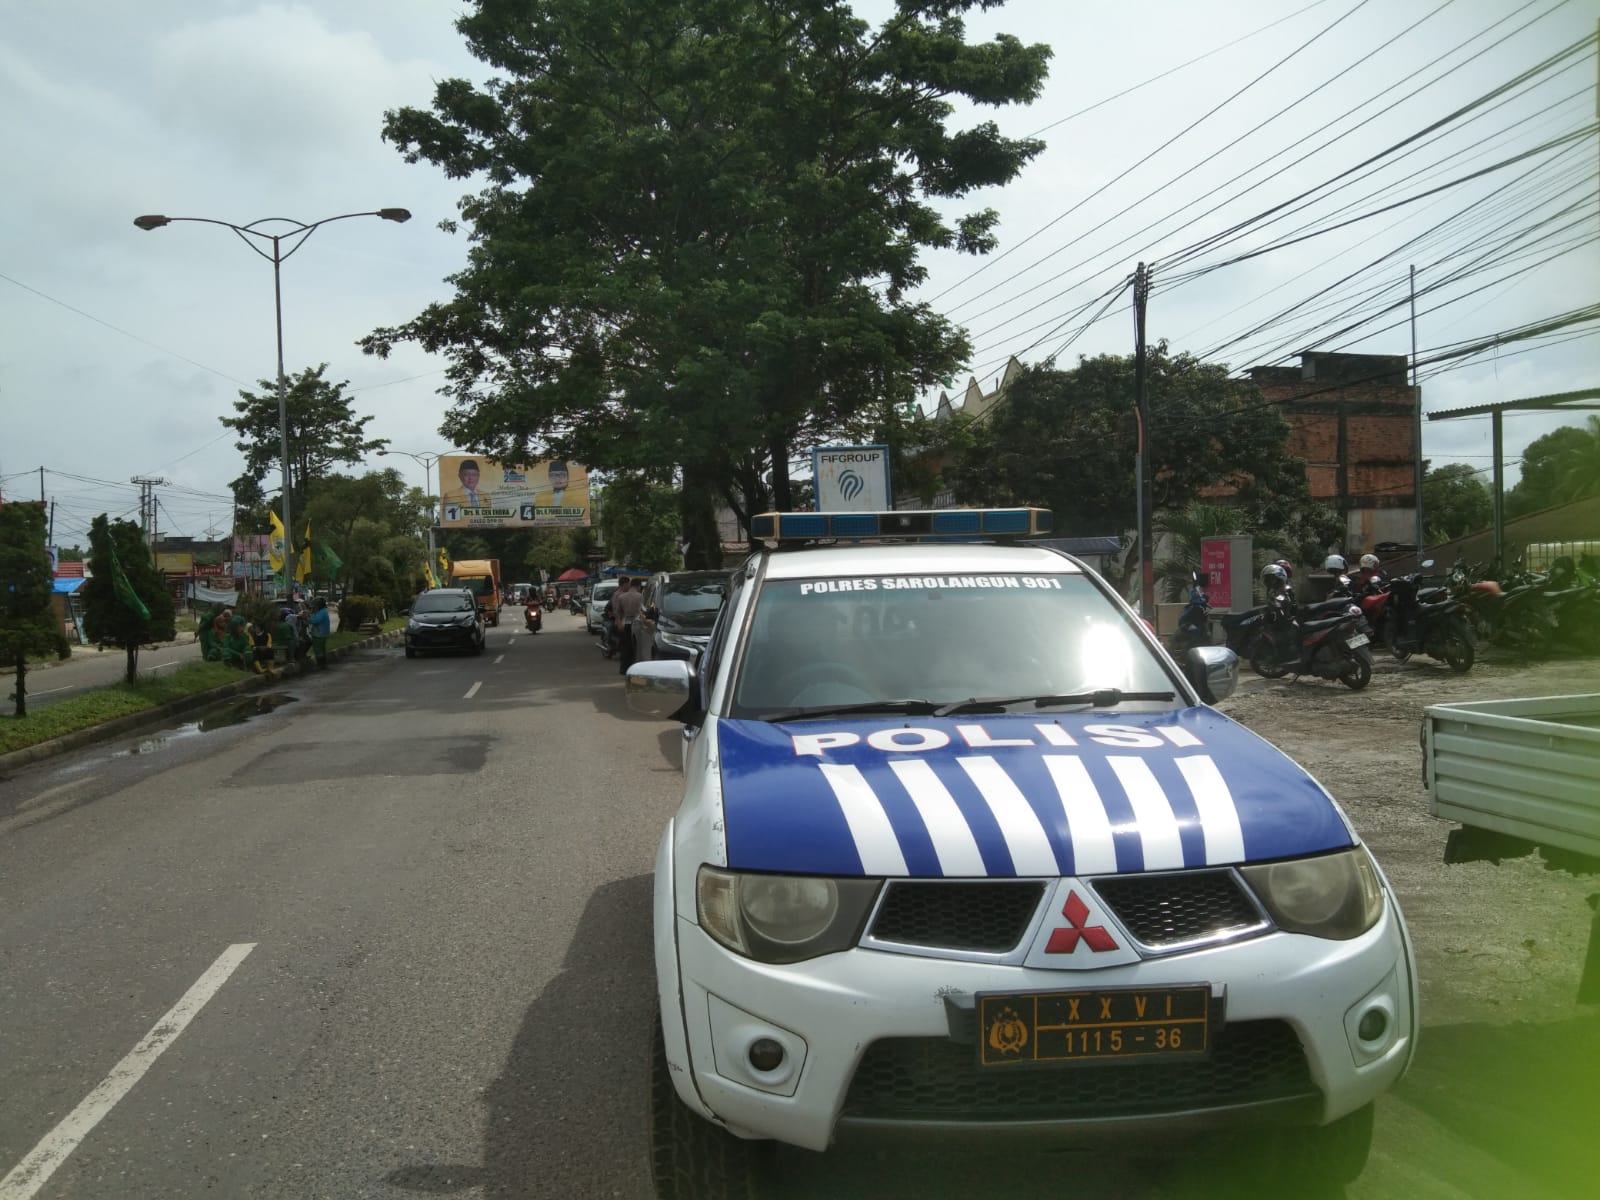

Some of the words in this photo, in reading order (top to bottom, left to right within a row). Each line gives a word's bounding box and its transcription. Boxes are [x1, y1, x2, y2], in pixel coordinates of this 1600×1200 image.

[821, 453, 880, 464] FIFGROUP
[801, 578, 877, 595] POLRES
[882, 576, 1020, 590] SAROLANGUN
[1022, 577, 1062, 590] 901
[791, 723, 1206, 757] POLISI
